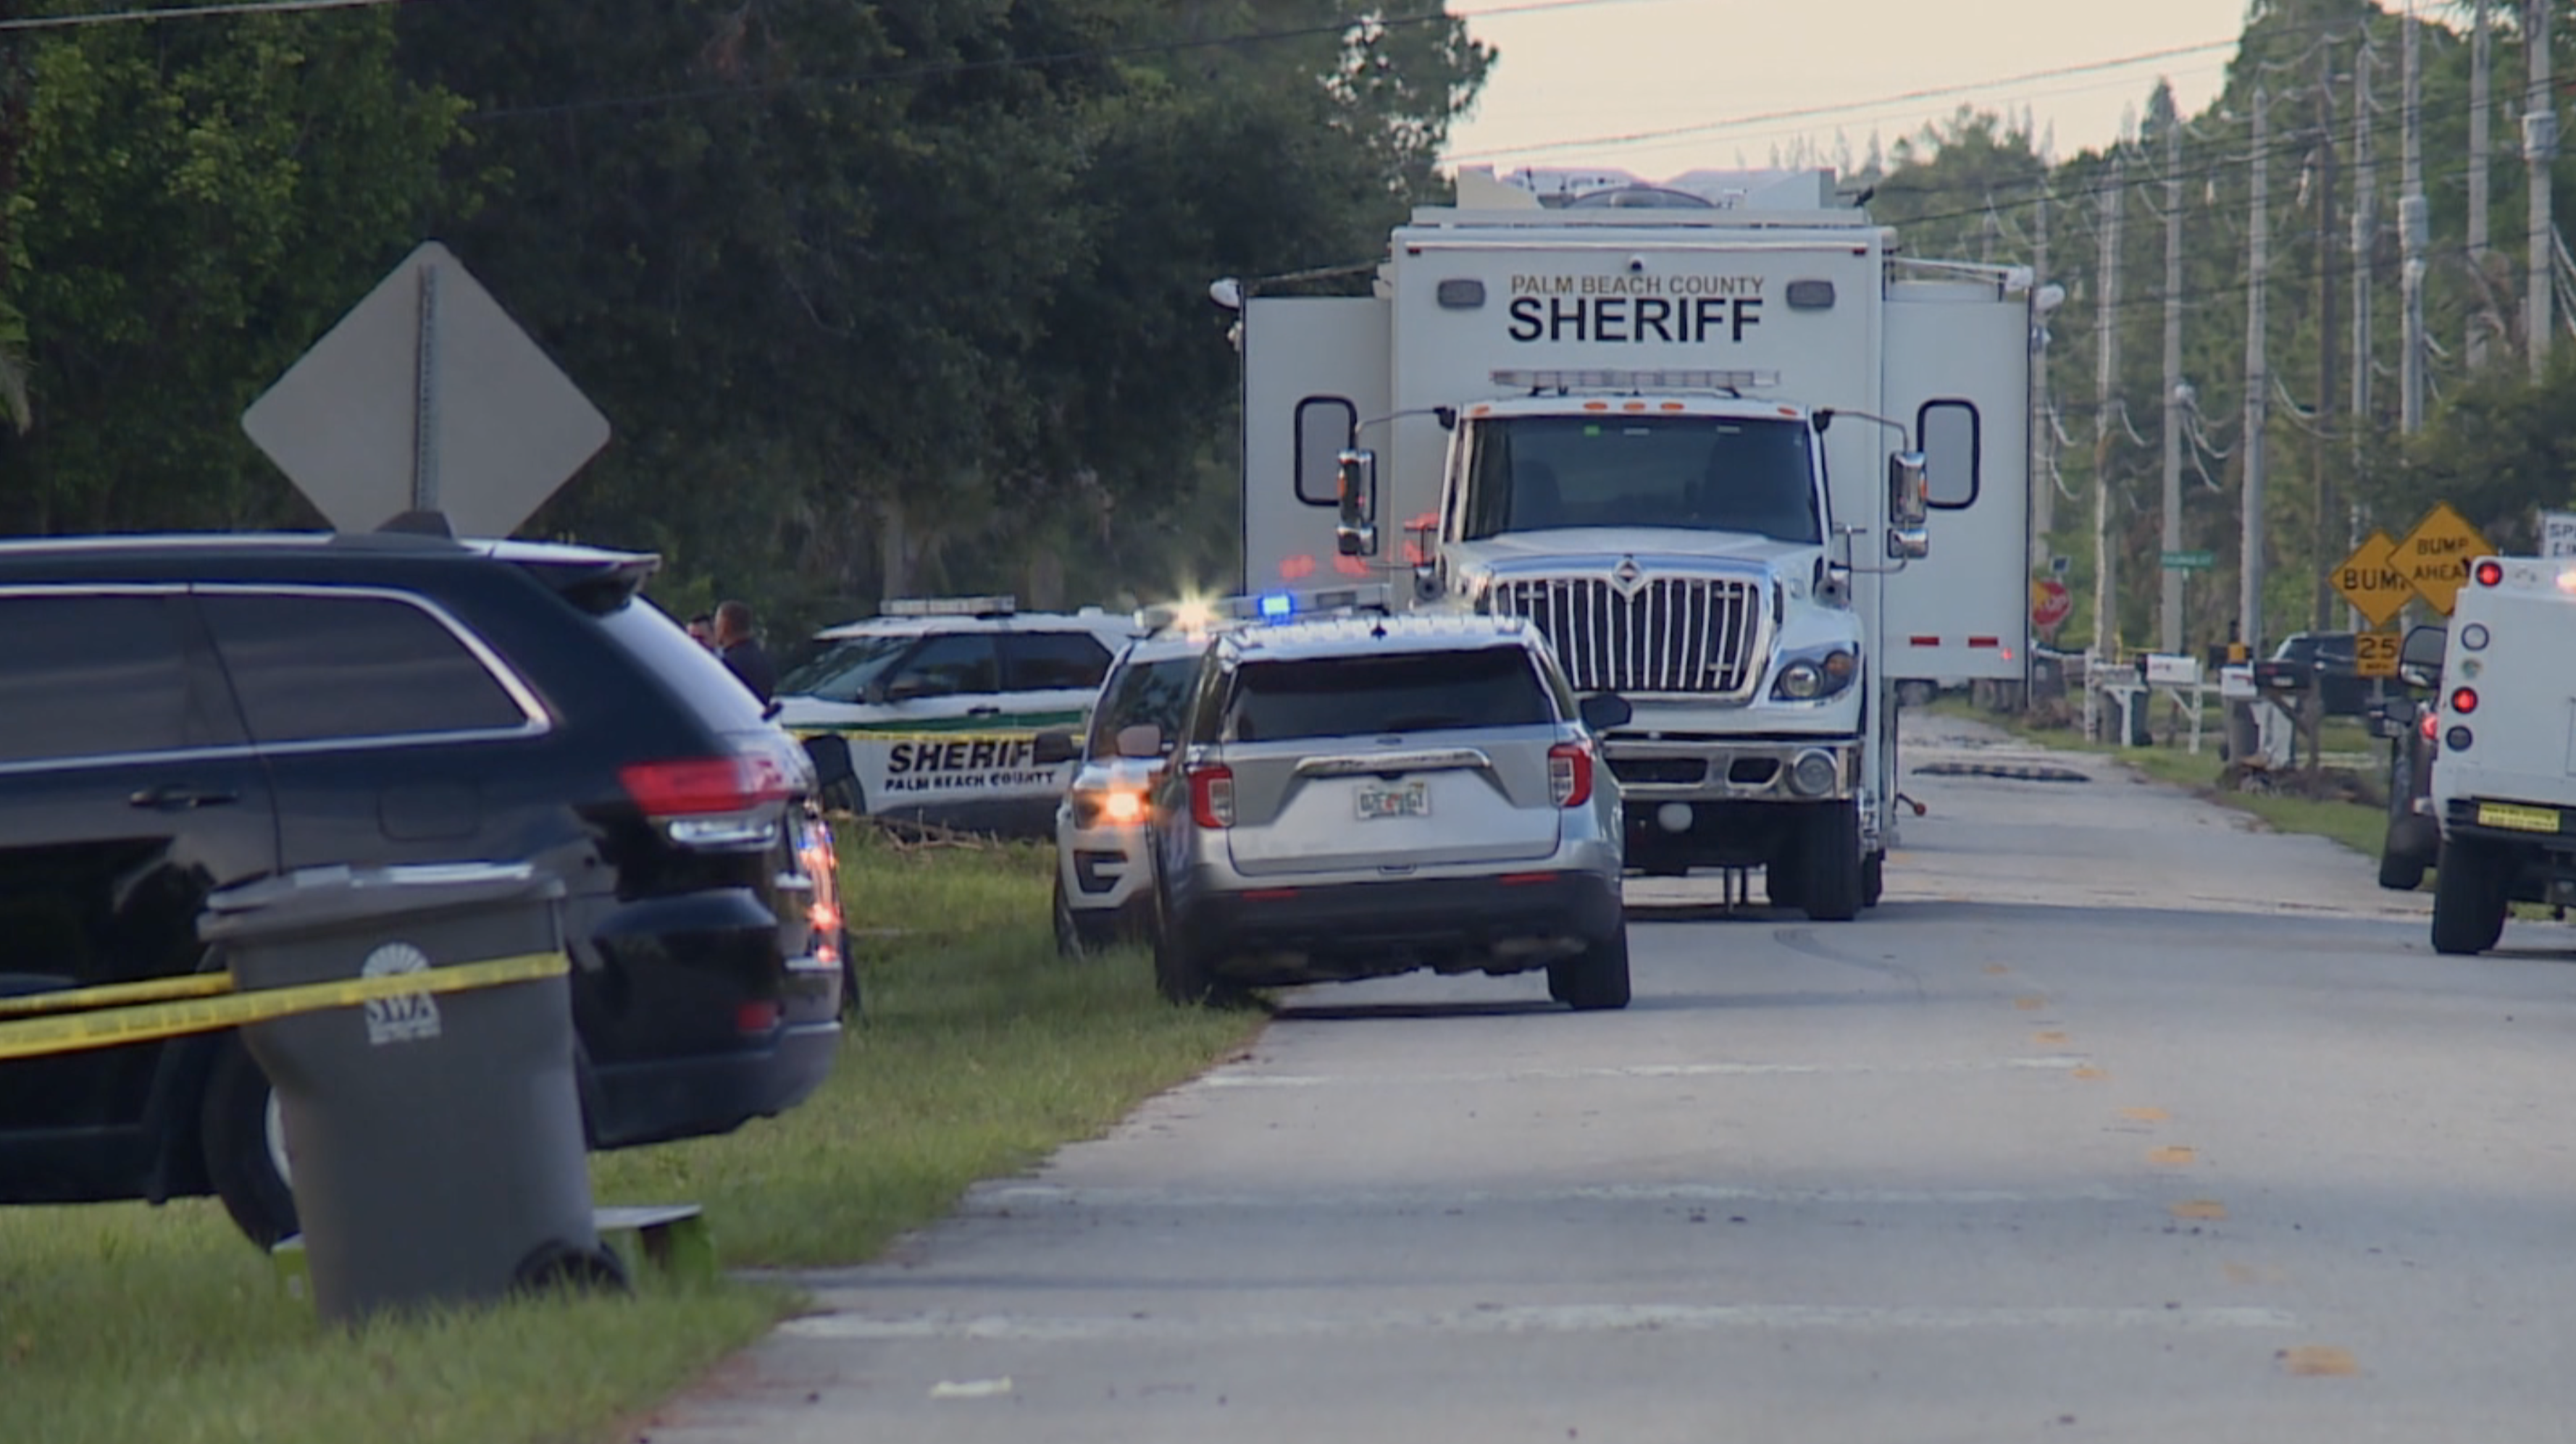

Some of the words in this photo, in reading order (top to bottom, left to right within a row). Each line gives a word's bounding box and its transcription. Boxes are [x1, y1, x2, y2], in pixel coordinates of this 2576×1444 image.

[1511, 275, 1574, 295] PALM
[1581, 275, 1662, 295] BEACH
[1669, 276, 1764, 295] COUNTY
[1508, 297, 1763, 343] SHERIFF
[2549, 524, 2576, 538] SP
[2417, 538, 2470, 555] BUMP
[2359, 637, 2397, 660] 25
[887, 739, 1037, 773] SHERIF
[885, 777, 929, 792] PALM
[934, 774, 984, 790] BEACH
[990, 771, 1056, 786] COUNTY
